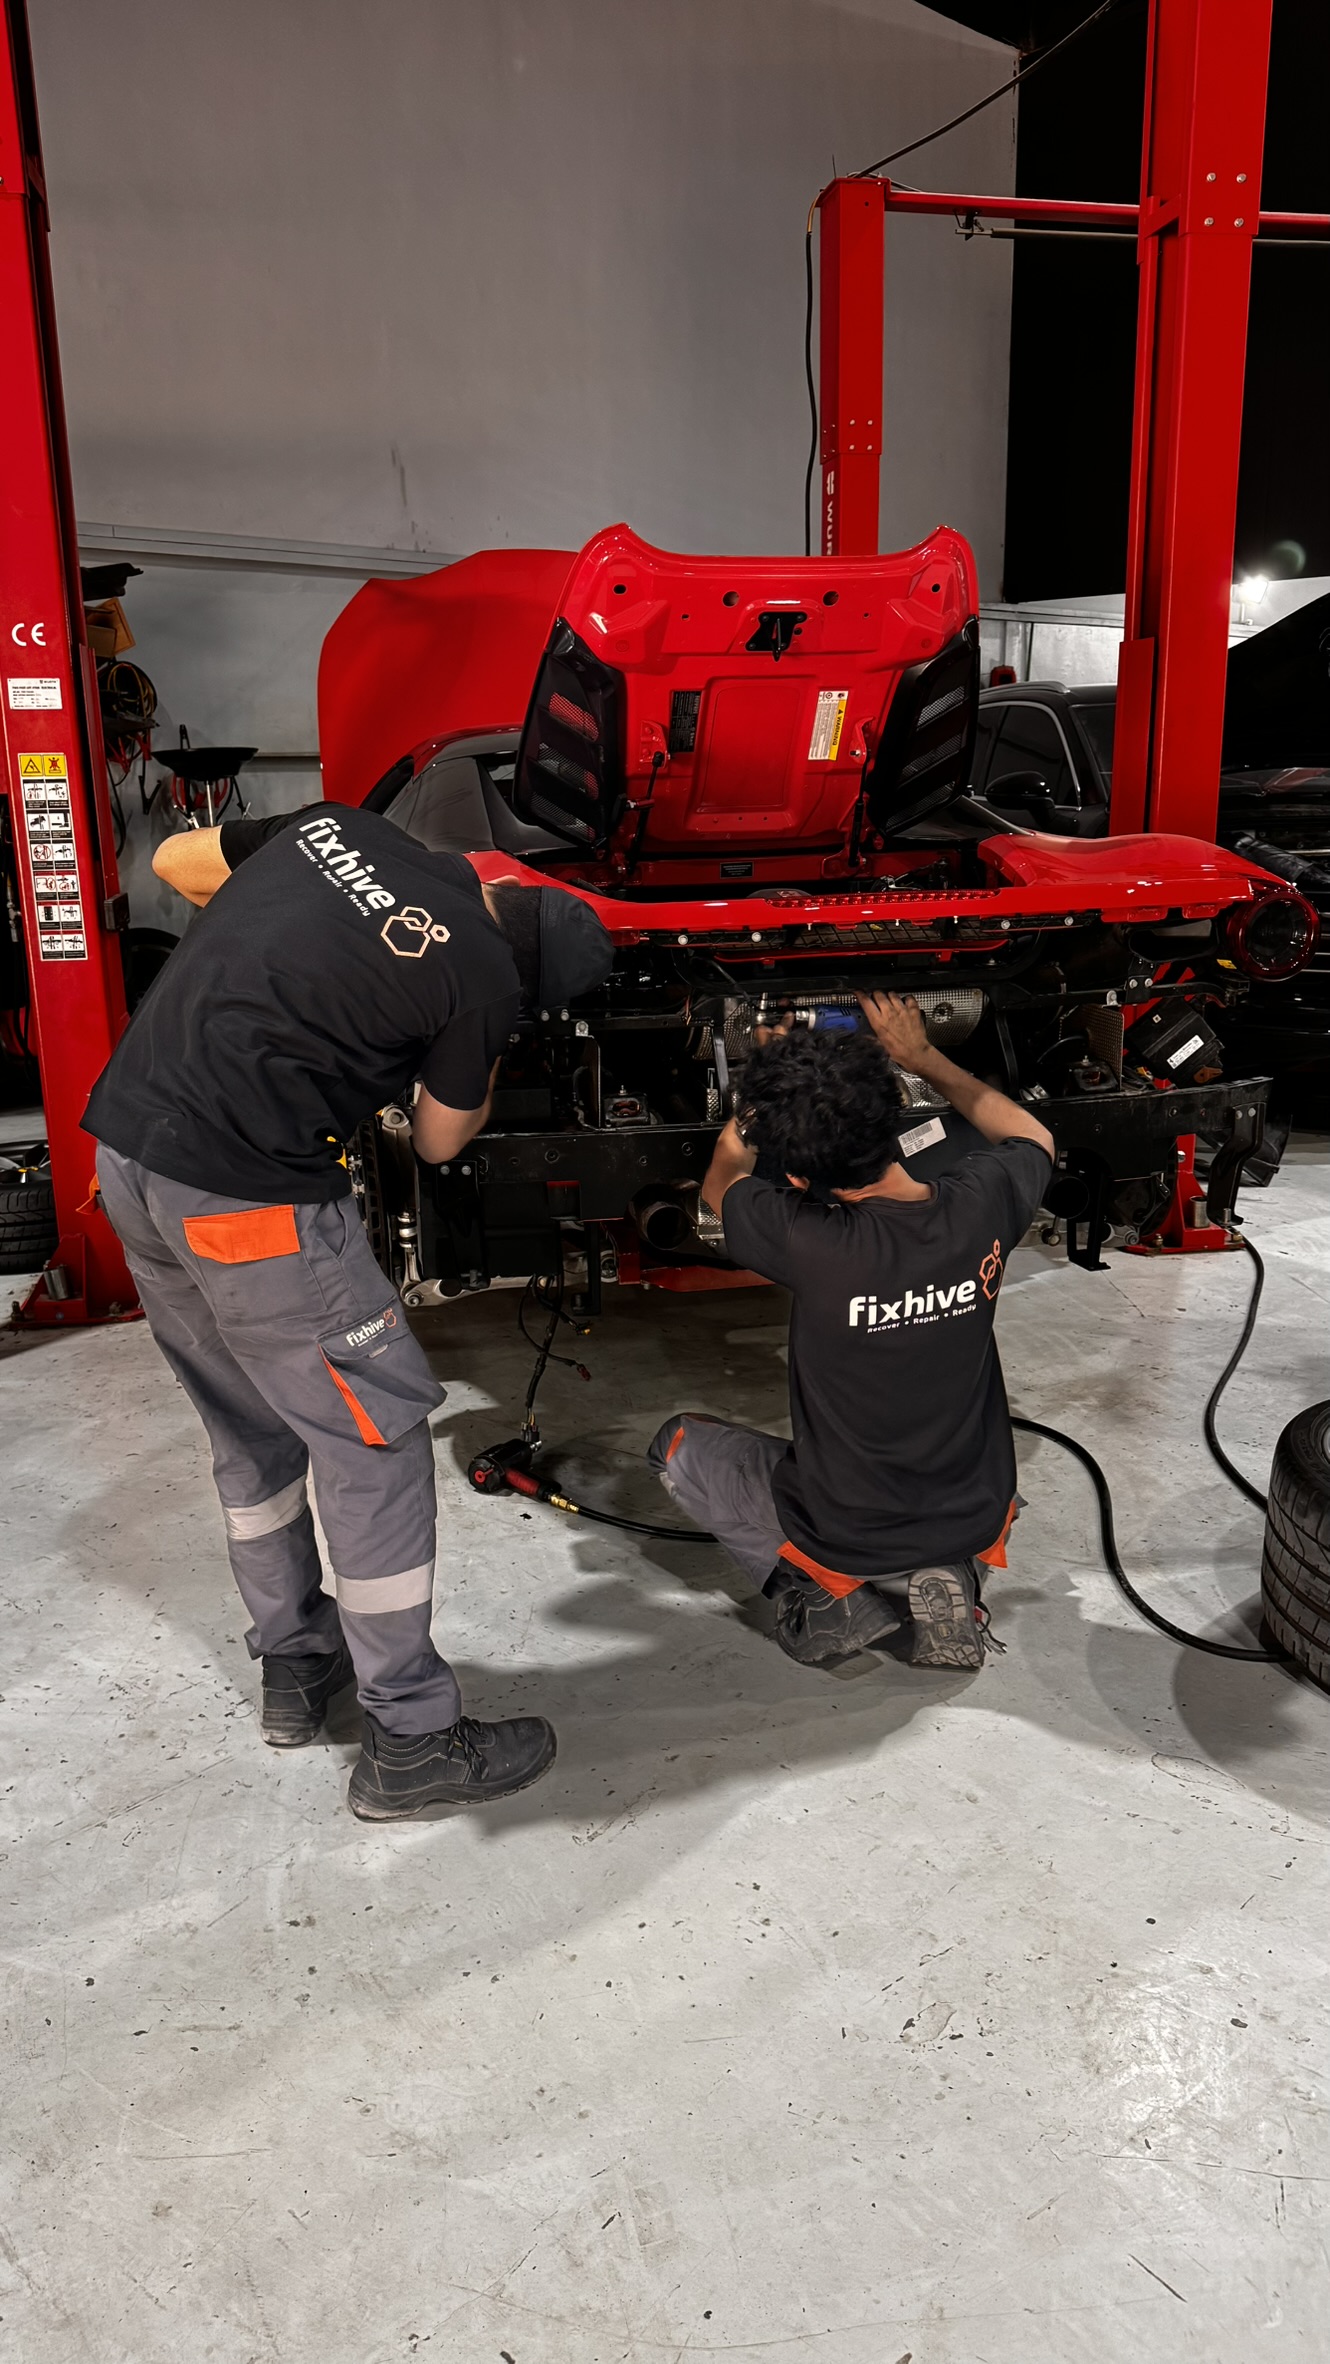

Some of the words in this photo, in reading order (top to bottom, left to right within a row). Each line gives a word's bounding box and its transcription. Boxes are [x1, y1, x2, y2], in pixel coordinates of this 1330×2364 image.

[11, 622, 47, 647] CE
[295, 838, 319, 863] Recover
[322, 870, 344, 889] Repair
[347, 893, 371, 917] Ready
[298, 817, 396, 910] fixhive
[849, 1279, 977, 1327] fixhive
[867, 1322, 900, 1334] Recover
[913, 1314, 940, 1325] Repair
[952, 1303, 977, 1317] Ready
[345, 1318, 385, 1347] fixhive
